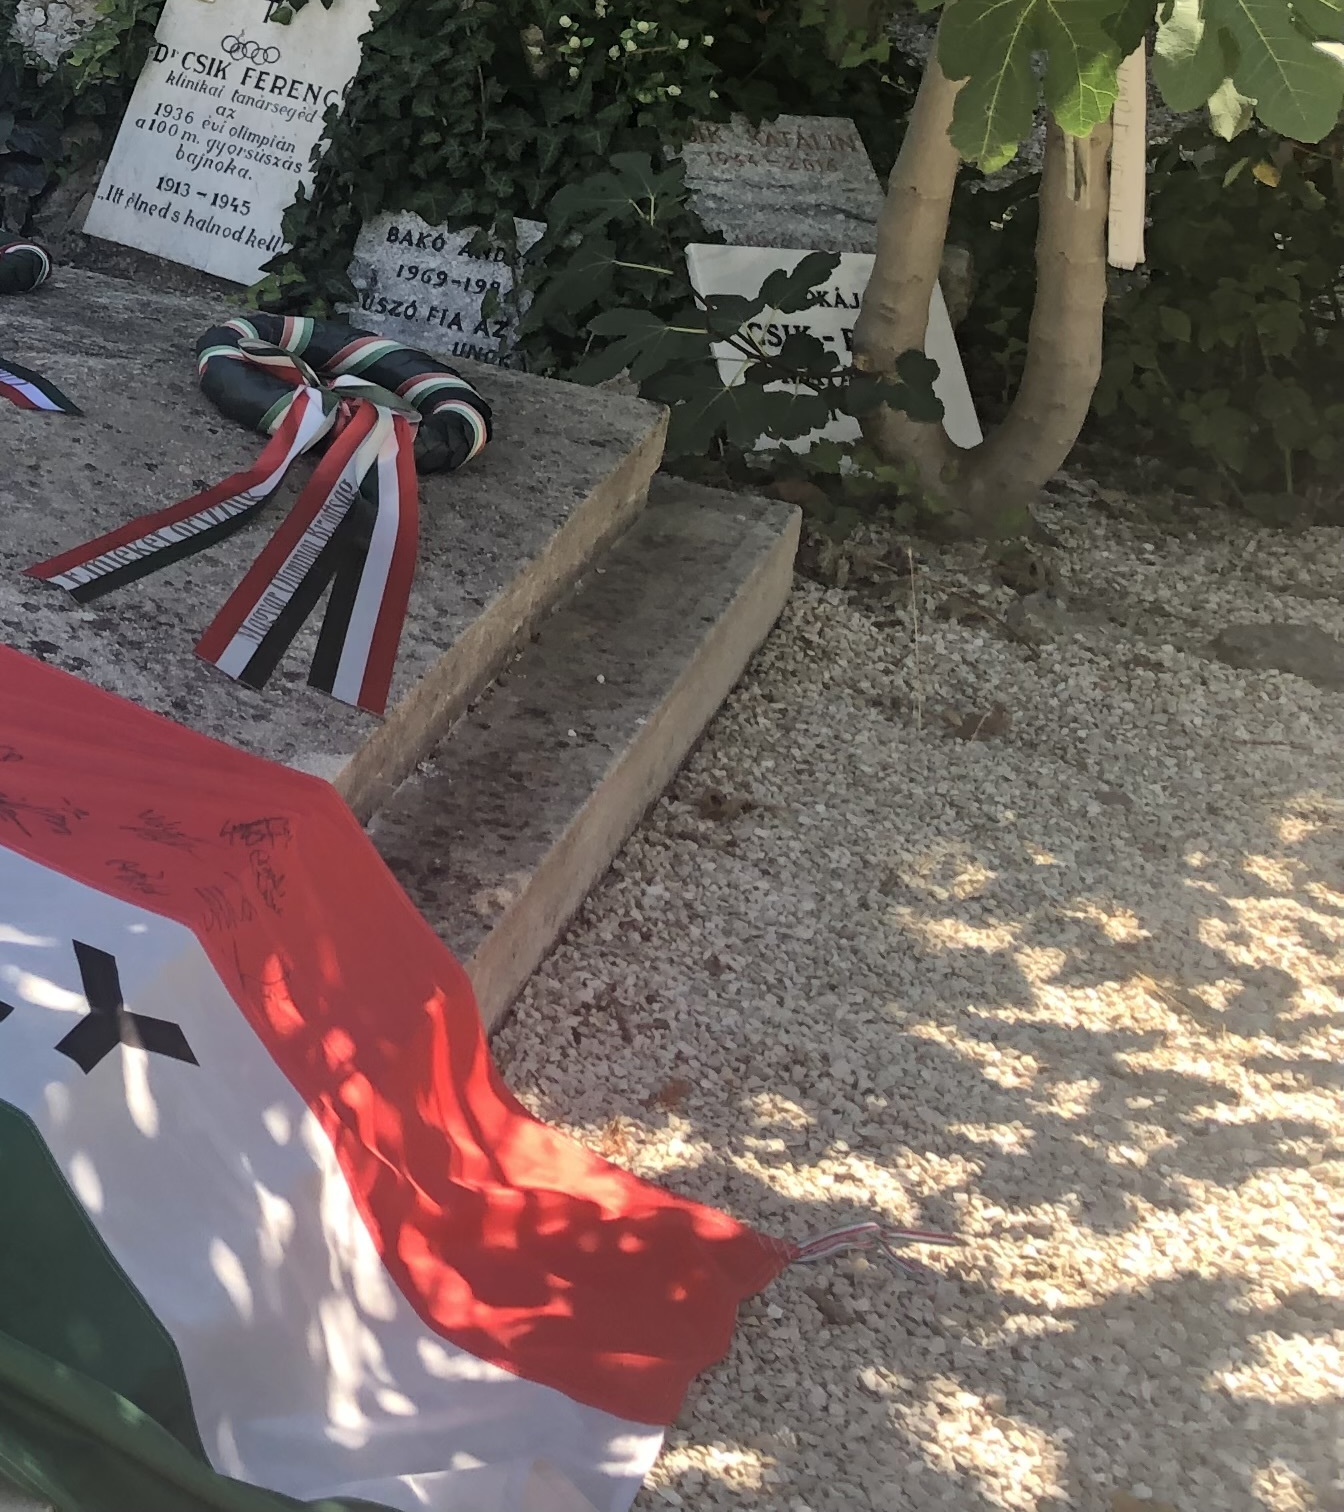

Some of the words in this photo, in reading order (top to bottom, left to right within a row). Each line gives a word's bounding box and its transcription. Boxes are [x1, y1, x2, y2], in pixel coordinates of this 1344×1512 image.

[165, 70, 226, 98] klinikai
[181, 51, 233, 80] CSIK
[240, 66, 339, 108] FERENC
[154, 102, 194, 124] 1936
[202, 115, 226, 135] évi
[215, 104, 238, 120] az
[175, 143, 253, 181] bajnoka.
[155, 176, 192, 198] 1913
[210, 192, 252, 217] 1945
[385, 226, 446, 253] BAKÓ
[426, 305, 464, 333] FIA
[473, 319, 510, 339] AZ
